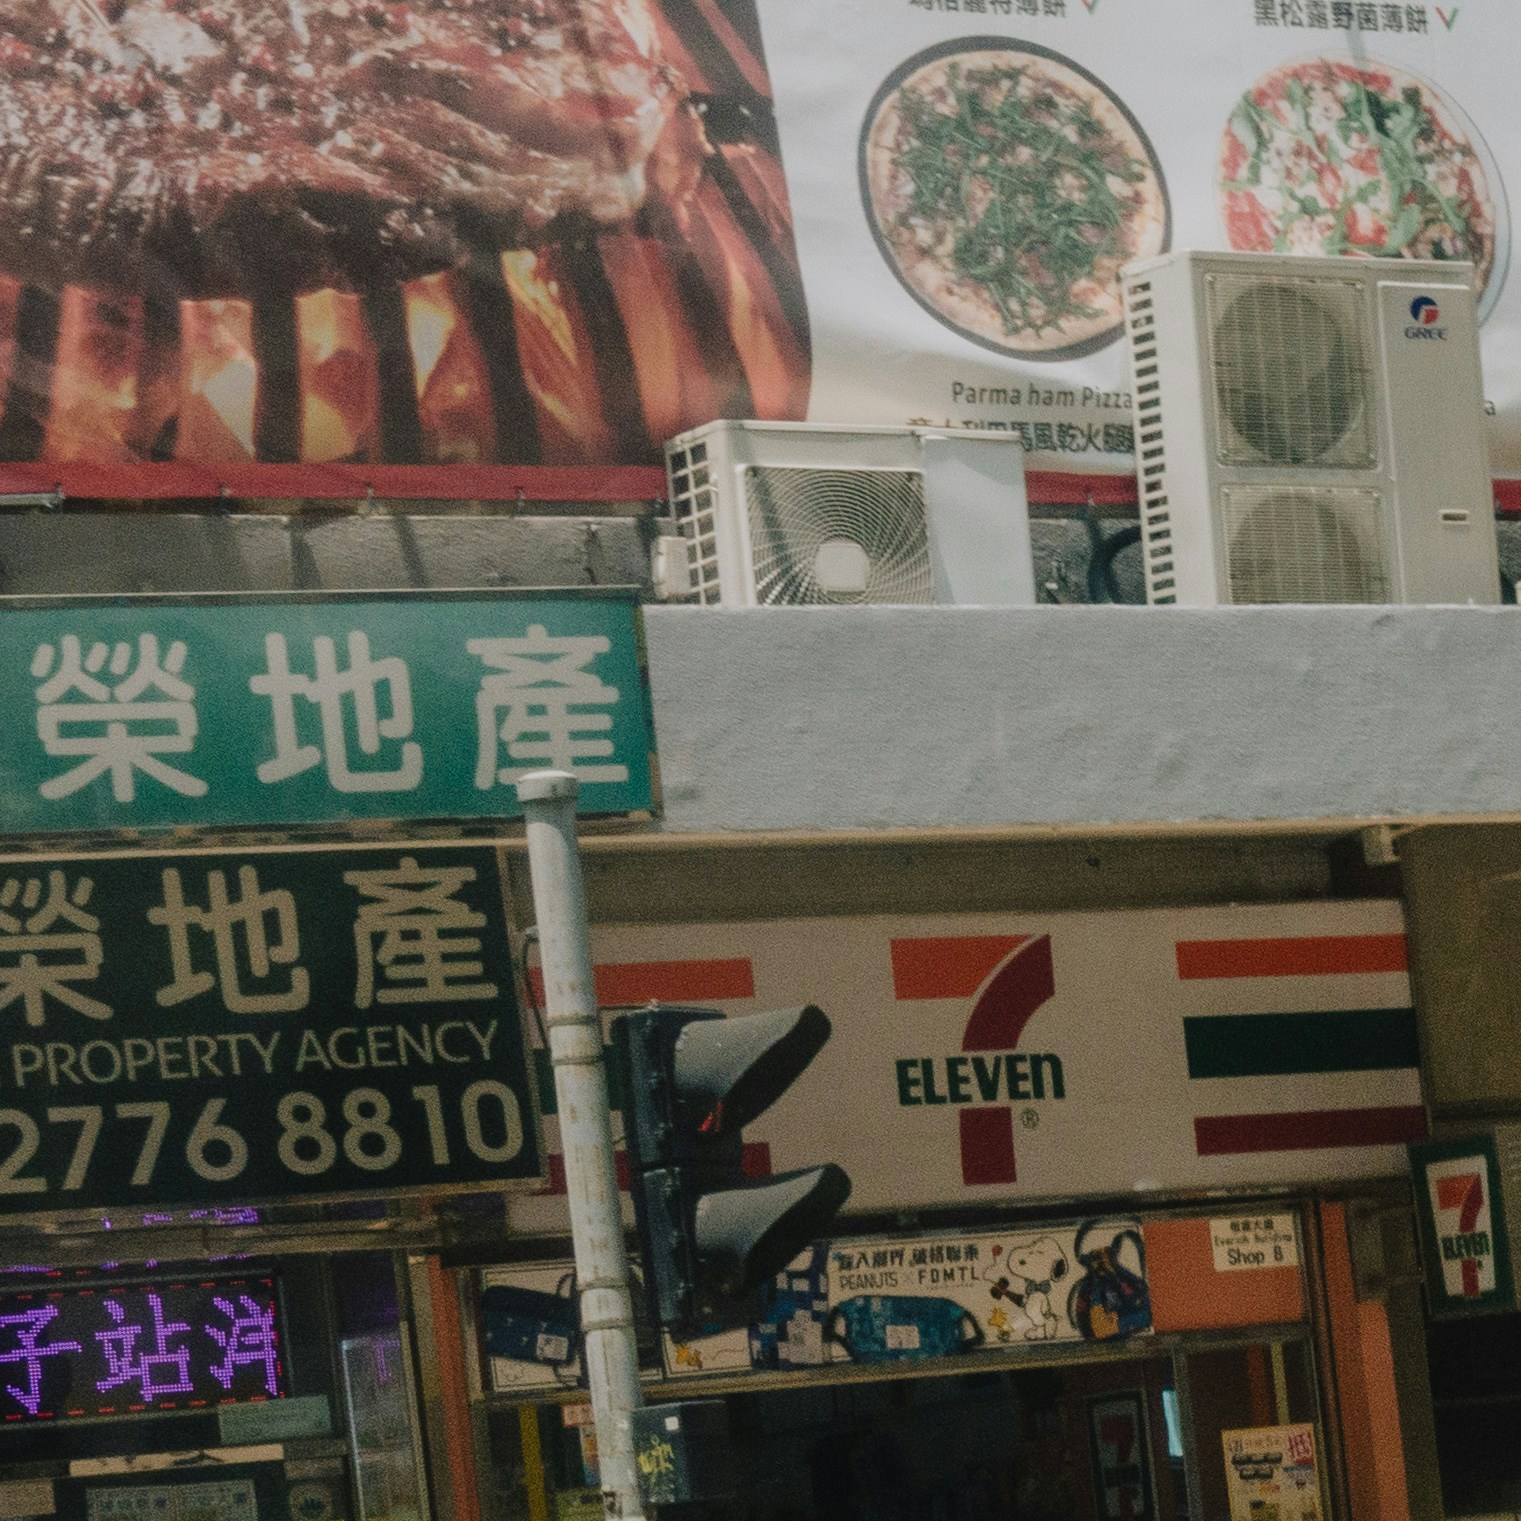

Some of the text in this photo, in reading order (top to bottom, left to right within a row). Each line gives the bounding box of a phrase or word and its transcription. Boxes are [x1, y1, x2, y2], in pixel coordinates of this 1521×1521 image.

[951, 382, 1132, 409] Parma ham Pizza
[30, 624, 629, 802] 榮地產
[0, 857, 498, 1027] 榮地產
[12, 1019, 499, 1086] PROPERTY AGENCY
[0, 1079, 524, 1194] 2776 8810
[838, 1271, 899, 1291] PEANUTS
[918, 1266, 980, 1284] FDMTL
[1228, 1248, 1265, 1265] Shop
